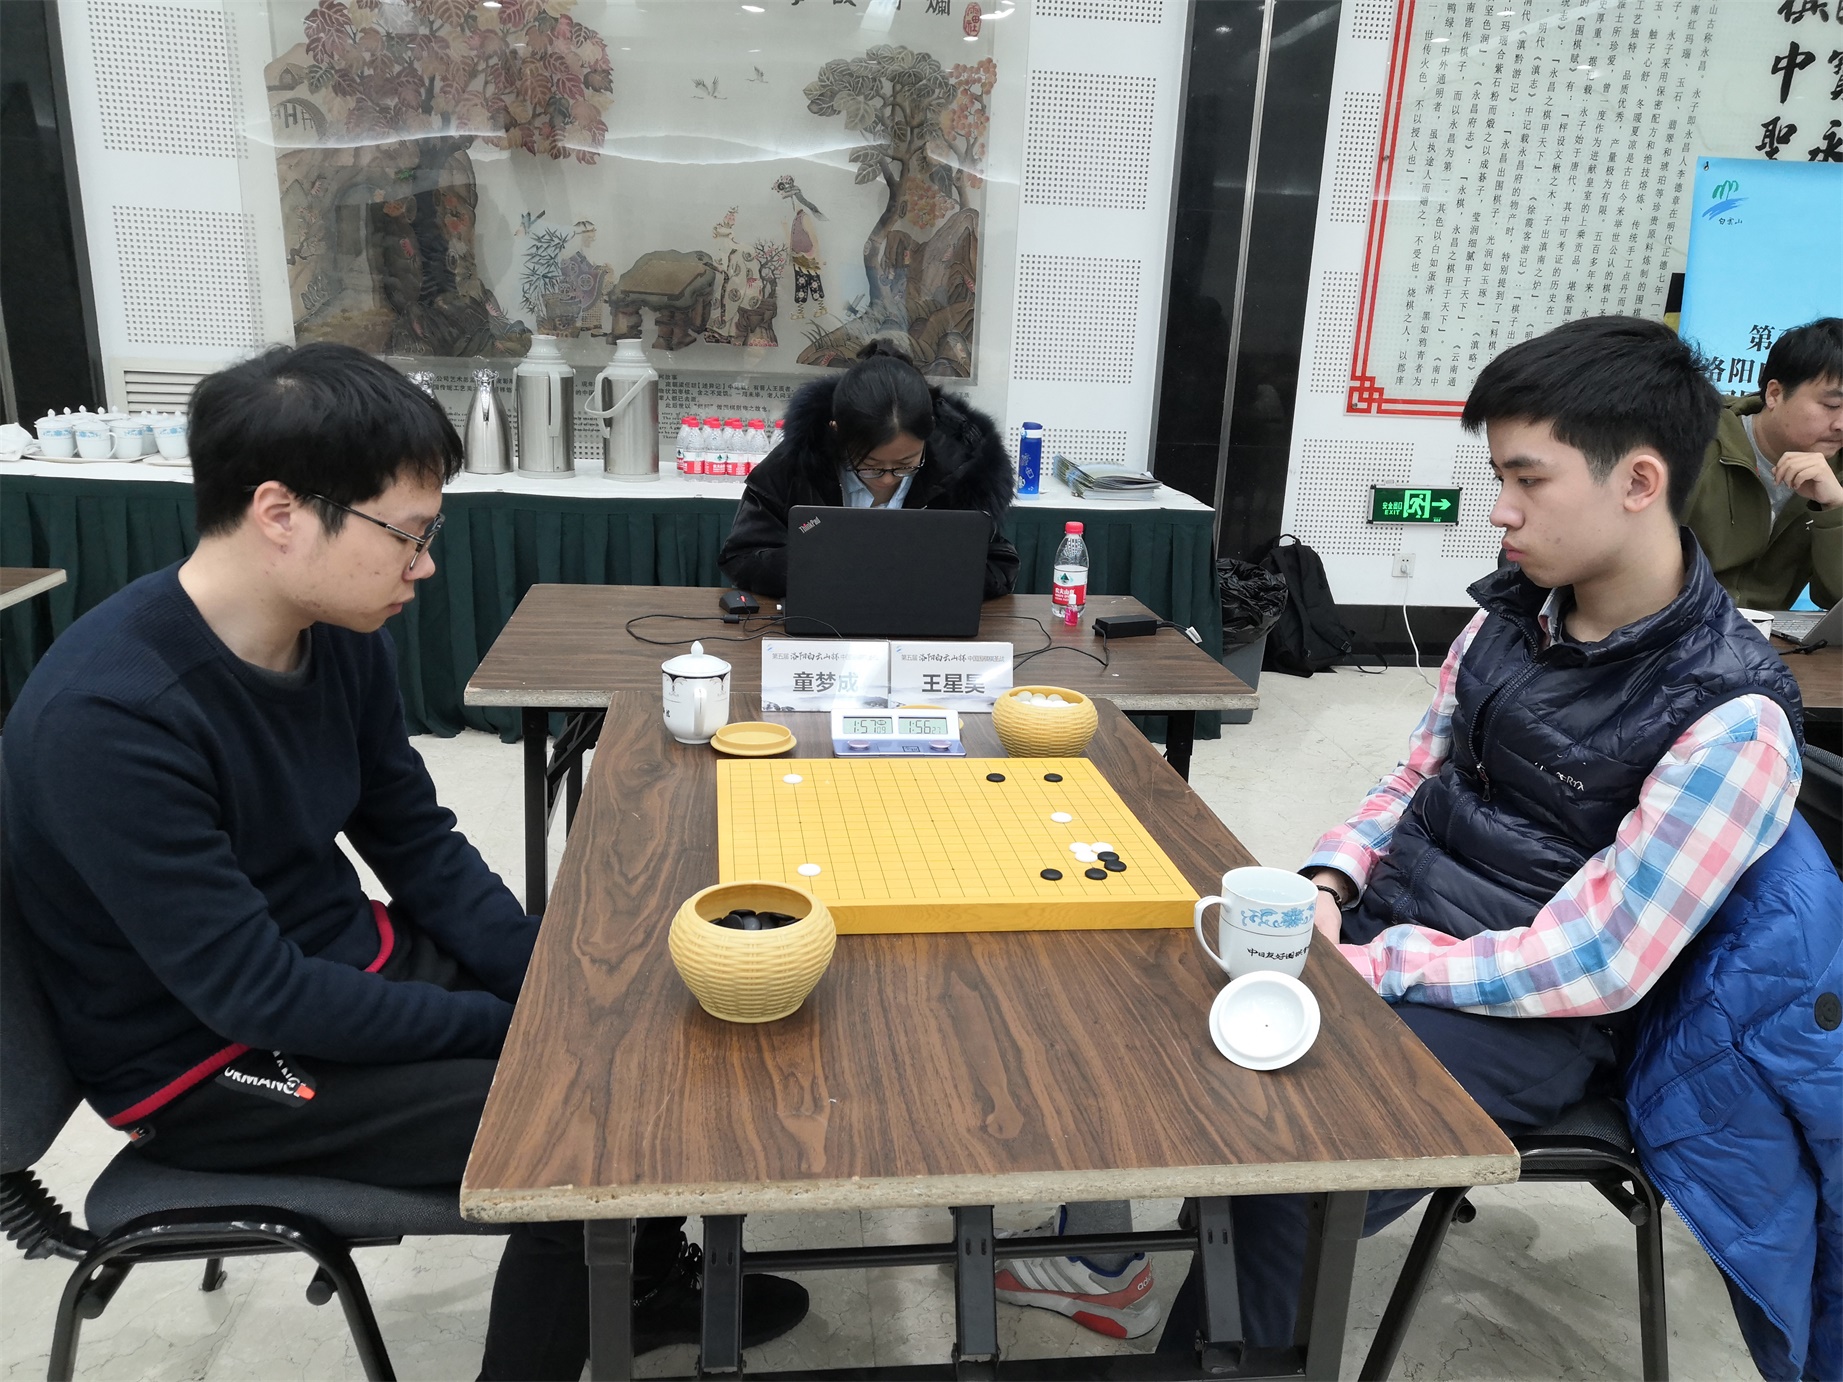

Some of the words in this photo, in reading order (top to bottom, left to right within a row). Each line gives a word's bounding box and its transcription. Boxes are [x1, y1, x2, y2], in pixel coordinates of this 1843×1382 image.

[1382, 501, 1403, 510] 安全出口
[798, 516, 821, 533] ThinkPad
[792, 671, 859, 693] 童梦成
